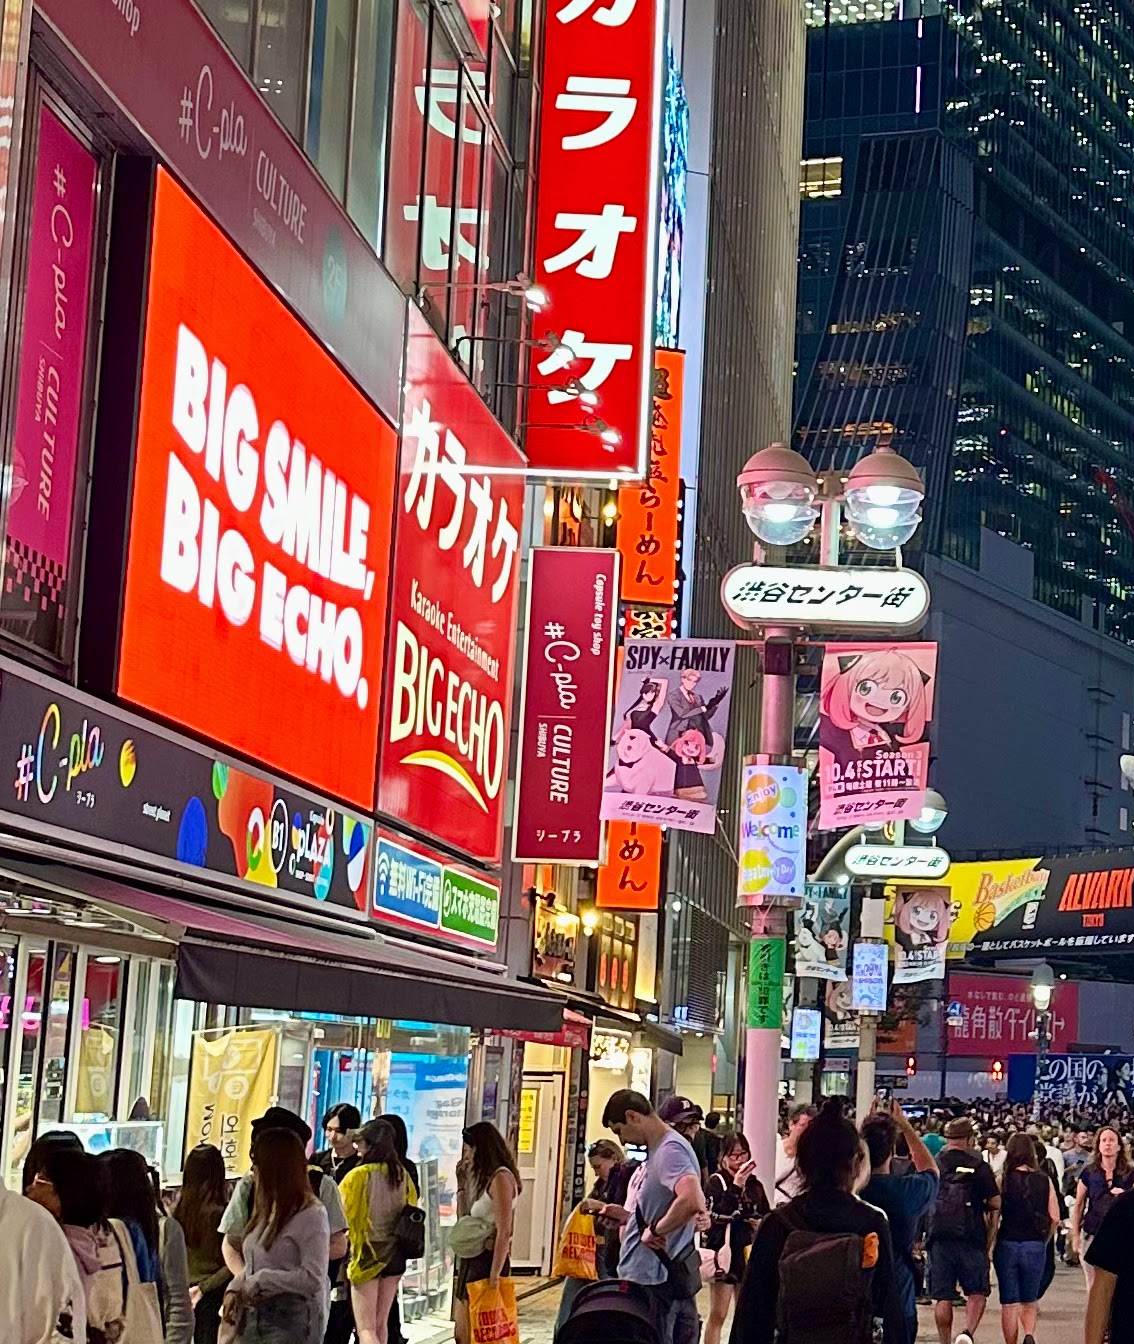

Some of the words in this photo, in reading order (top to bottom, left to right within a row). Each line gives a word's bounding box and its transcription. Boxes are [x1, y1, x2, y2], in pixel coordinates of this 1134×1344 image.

[256, 150, 308, 245] CULTURE
[36, 365, 61, 521] CULTURE
[172, 323, 260, 513] BIG
[260, 420, 376, 602] SMILE,
[403, 398, 518, 604] カラオケ
[161, 452, 256, 626] BIG
[259, 570, 369, 711] ECHO.
[592, 614, 604, 631] toy
[593, 573, 607, 613] Capsule
[732, 581, 918, 608] 渋谷センター街
[411, 577, 446, 636] Karaoke
[447, 610, 500, 682] Entertainment
[544, 621, 581, 710] #C-pla
[590, 631, 602, 656] shop
[390, 619, 446, 743] BIG
[446, 675, 504, 800] ECHO
[14, 703, 105, 804] #C-pla
[550, 723, 573, 805] CULTURE
[272, 819, 285, 852] B1
[619, 800, 700, 820] 渋谷センター街
[741, 820, 800, 840] Welcome
[853, 855, 945, 868] 渋谷センター街
